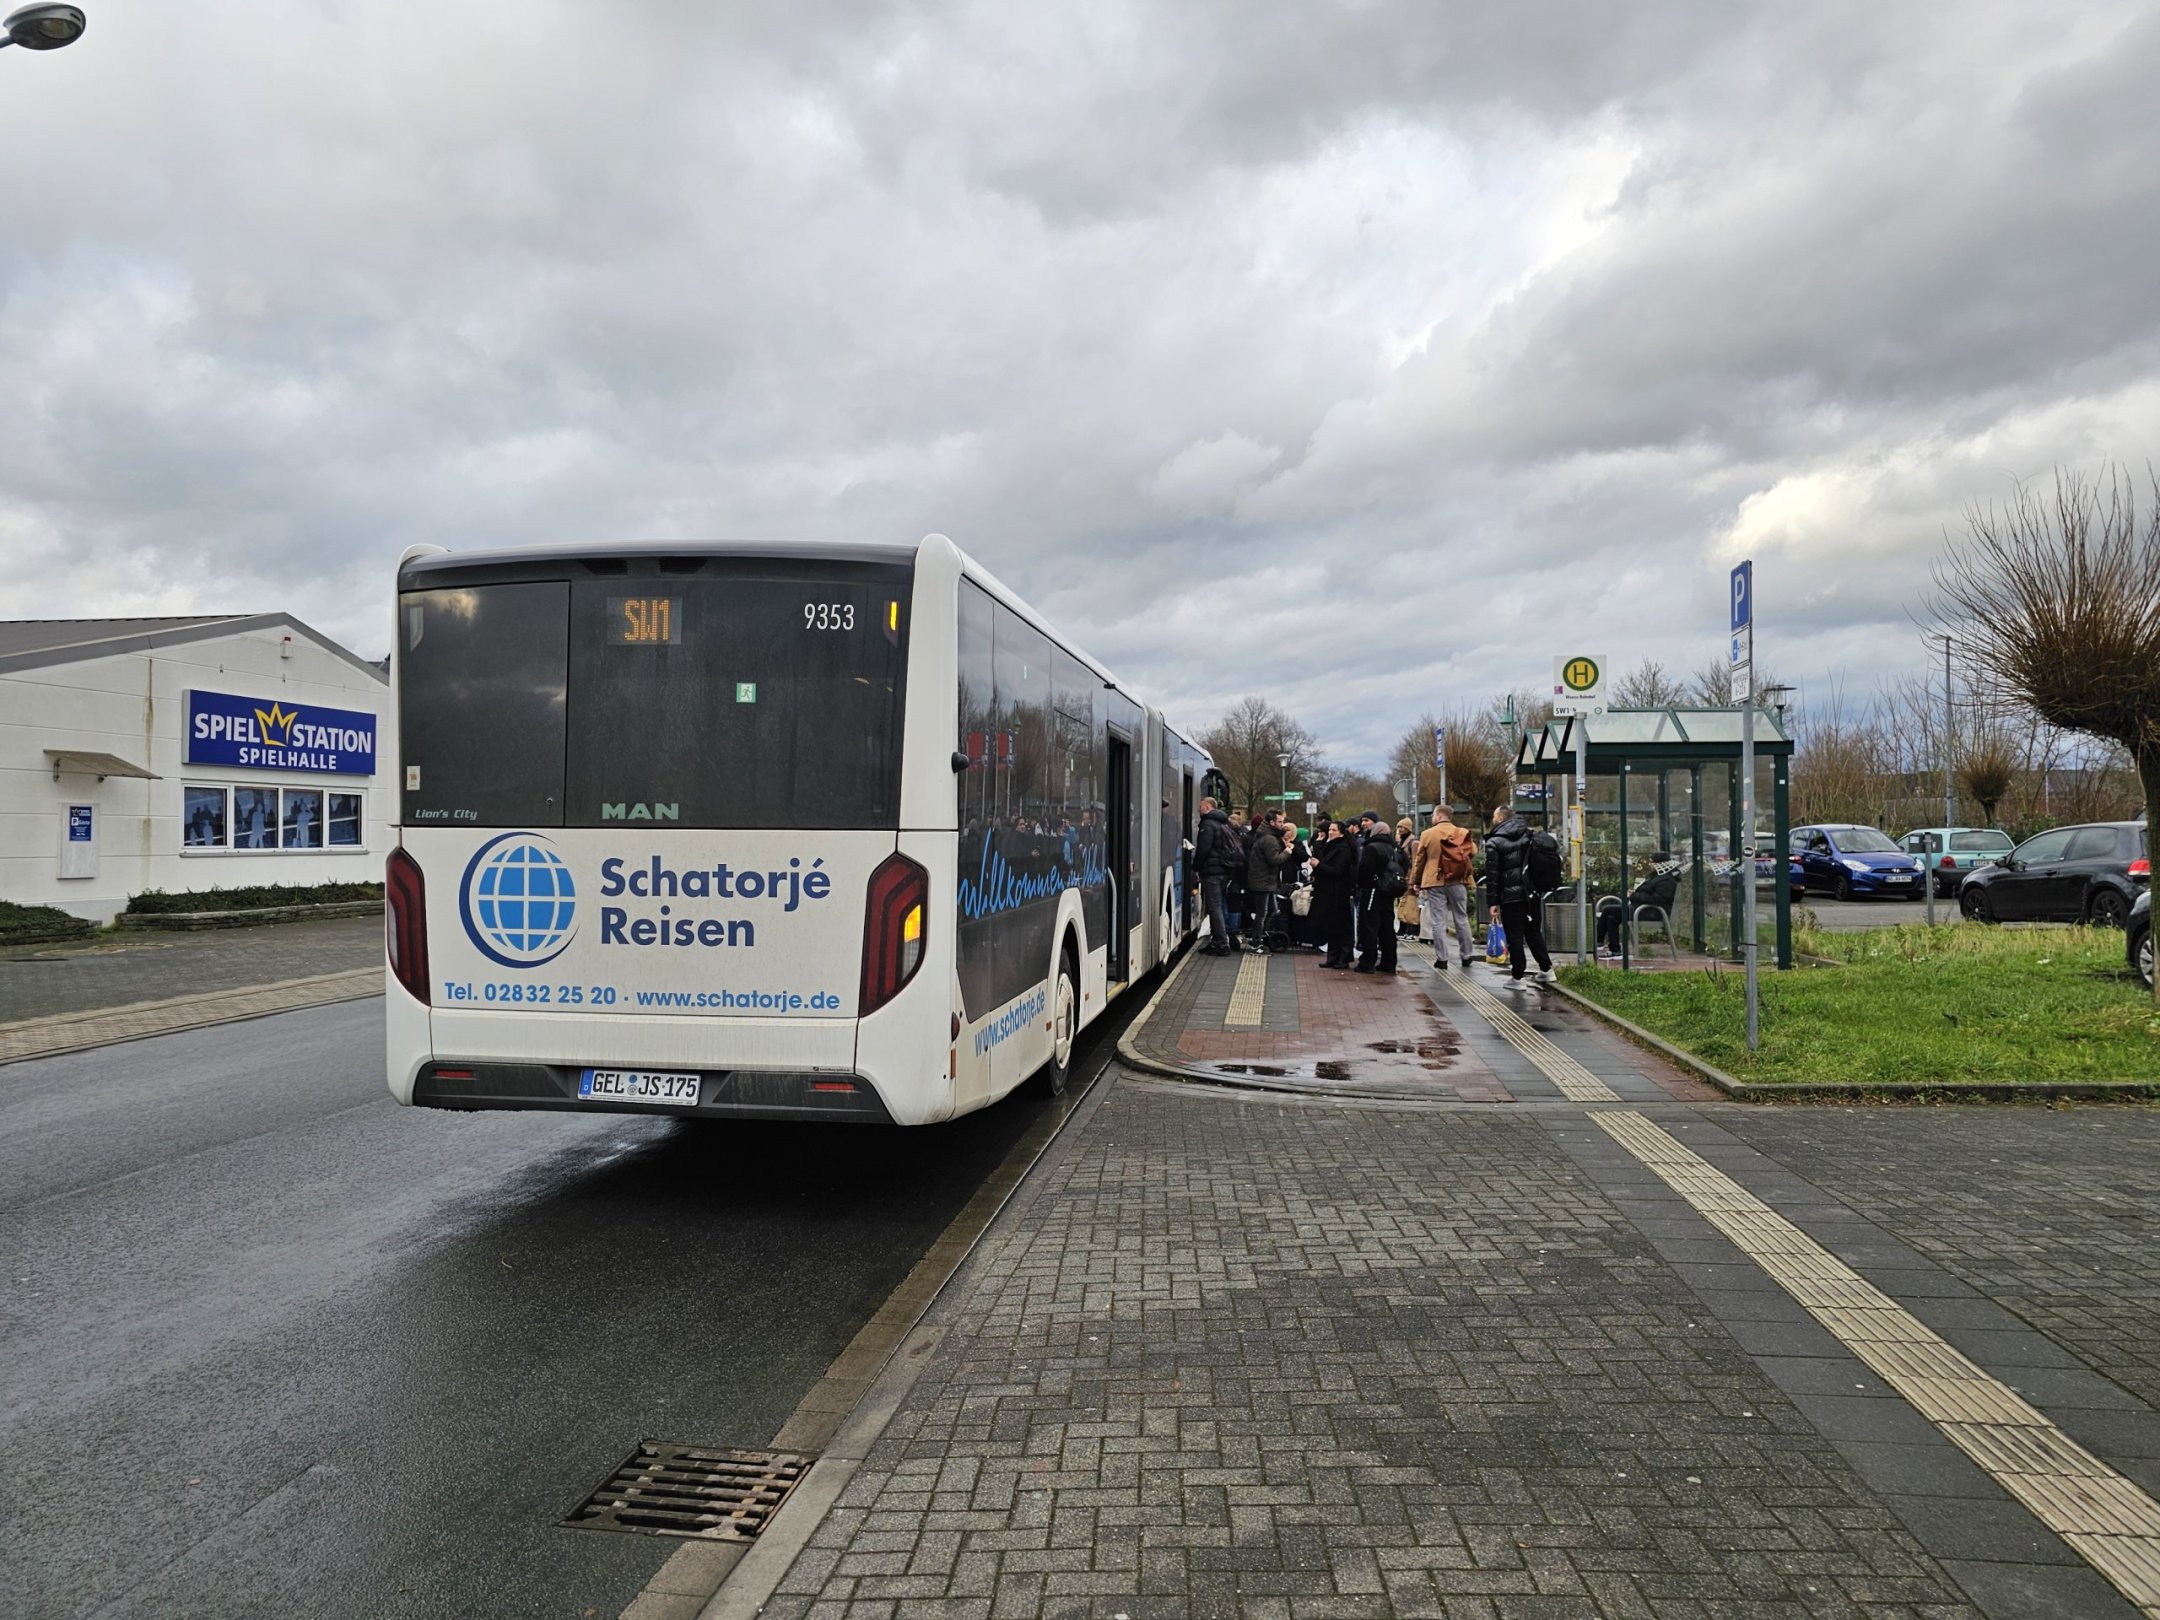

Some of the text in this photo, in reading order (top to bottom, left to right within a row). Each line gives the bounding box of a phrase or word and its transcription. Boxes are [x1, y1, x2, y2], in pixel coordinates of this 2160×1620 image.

[1735, 573, 1745, 622] P
[623, 600, 670, 641] SW1
[804, 603, 855, 630] 9353
[1573, 664, 1588, 684] H
[194, 713, 371, 753] SPIEL STATION
[239, 747, 337, 770] SPIELHALLE
[415, 809, 478, 821] Lion's City
[602, 803, 679, 820] MAN
[601, 855, 831, 911] Schatorjé
[958, 827, 1065, 920] Willkommen
[601, 906, 754, 947] Reisen
[445, 982, 841, 1014] Tel. 02832 25 20 www.schatorje.de
[974, 986, 1046, 1058] www.schatorje.de
[592, 1073, 697, 1098] GEL JS 175
